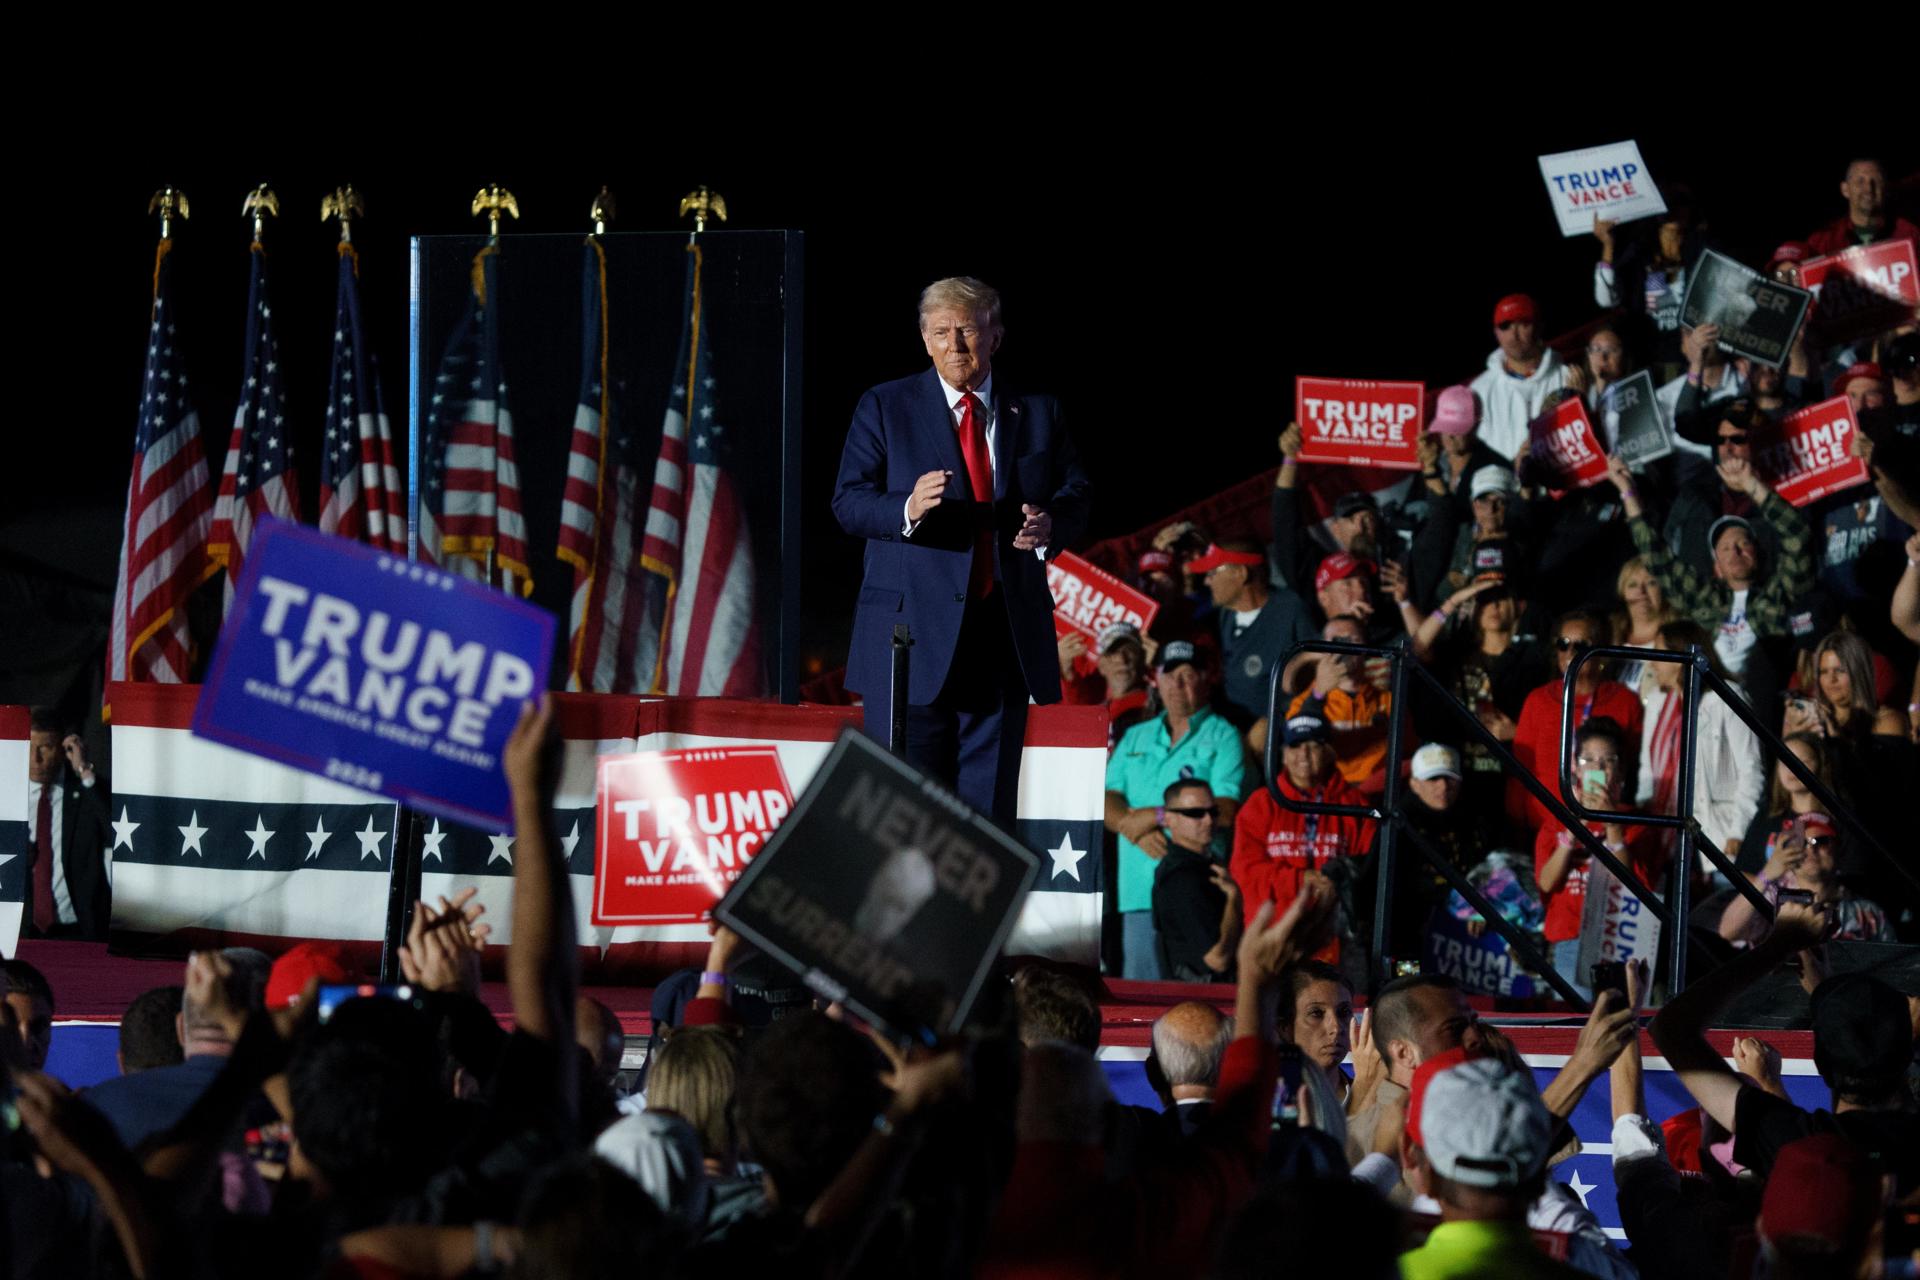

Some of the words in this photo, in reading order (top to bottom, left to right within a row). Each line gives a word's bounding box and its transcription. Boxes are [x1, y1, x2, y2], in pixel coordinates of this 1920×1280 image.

[1552, 163, 1638, 192] TRUMP
[1567, 181, 1637, 206] VANCE
[1304, 398, 1417, 426] TRUMP
[1316, 418, 1404, 441] VANCE
[1051, 588, 1110, 633] VANC
[257, 575, 535, 708] TRUMP
[274, 637, 493, 748] VANCE
[614, 789, 788, 841] TRUMP
[638, 831, 775, 874] VANC
[1617, 896, 1640, 966] RUM
[1437, 956, 1512, 997] VANCE
